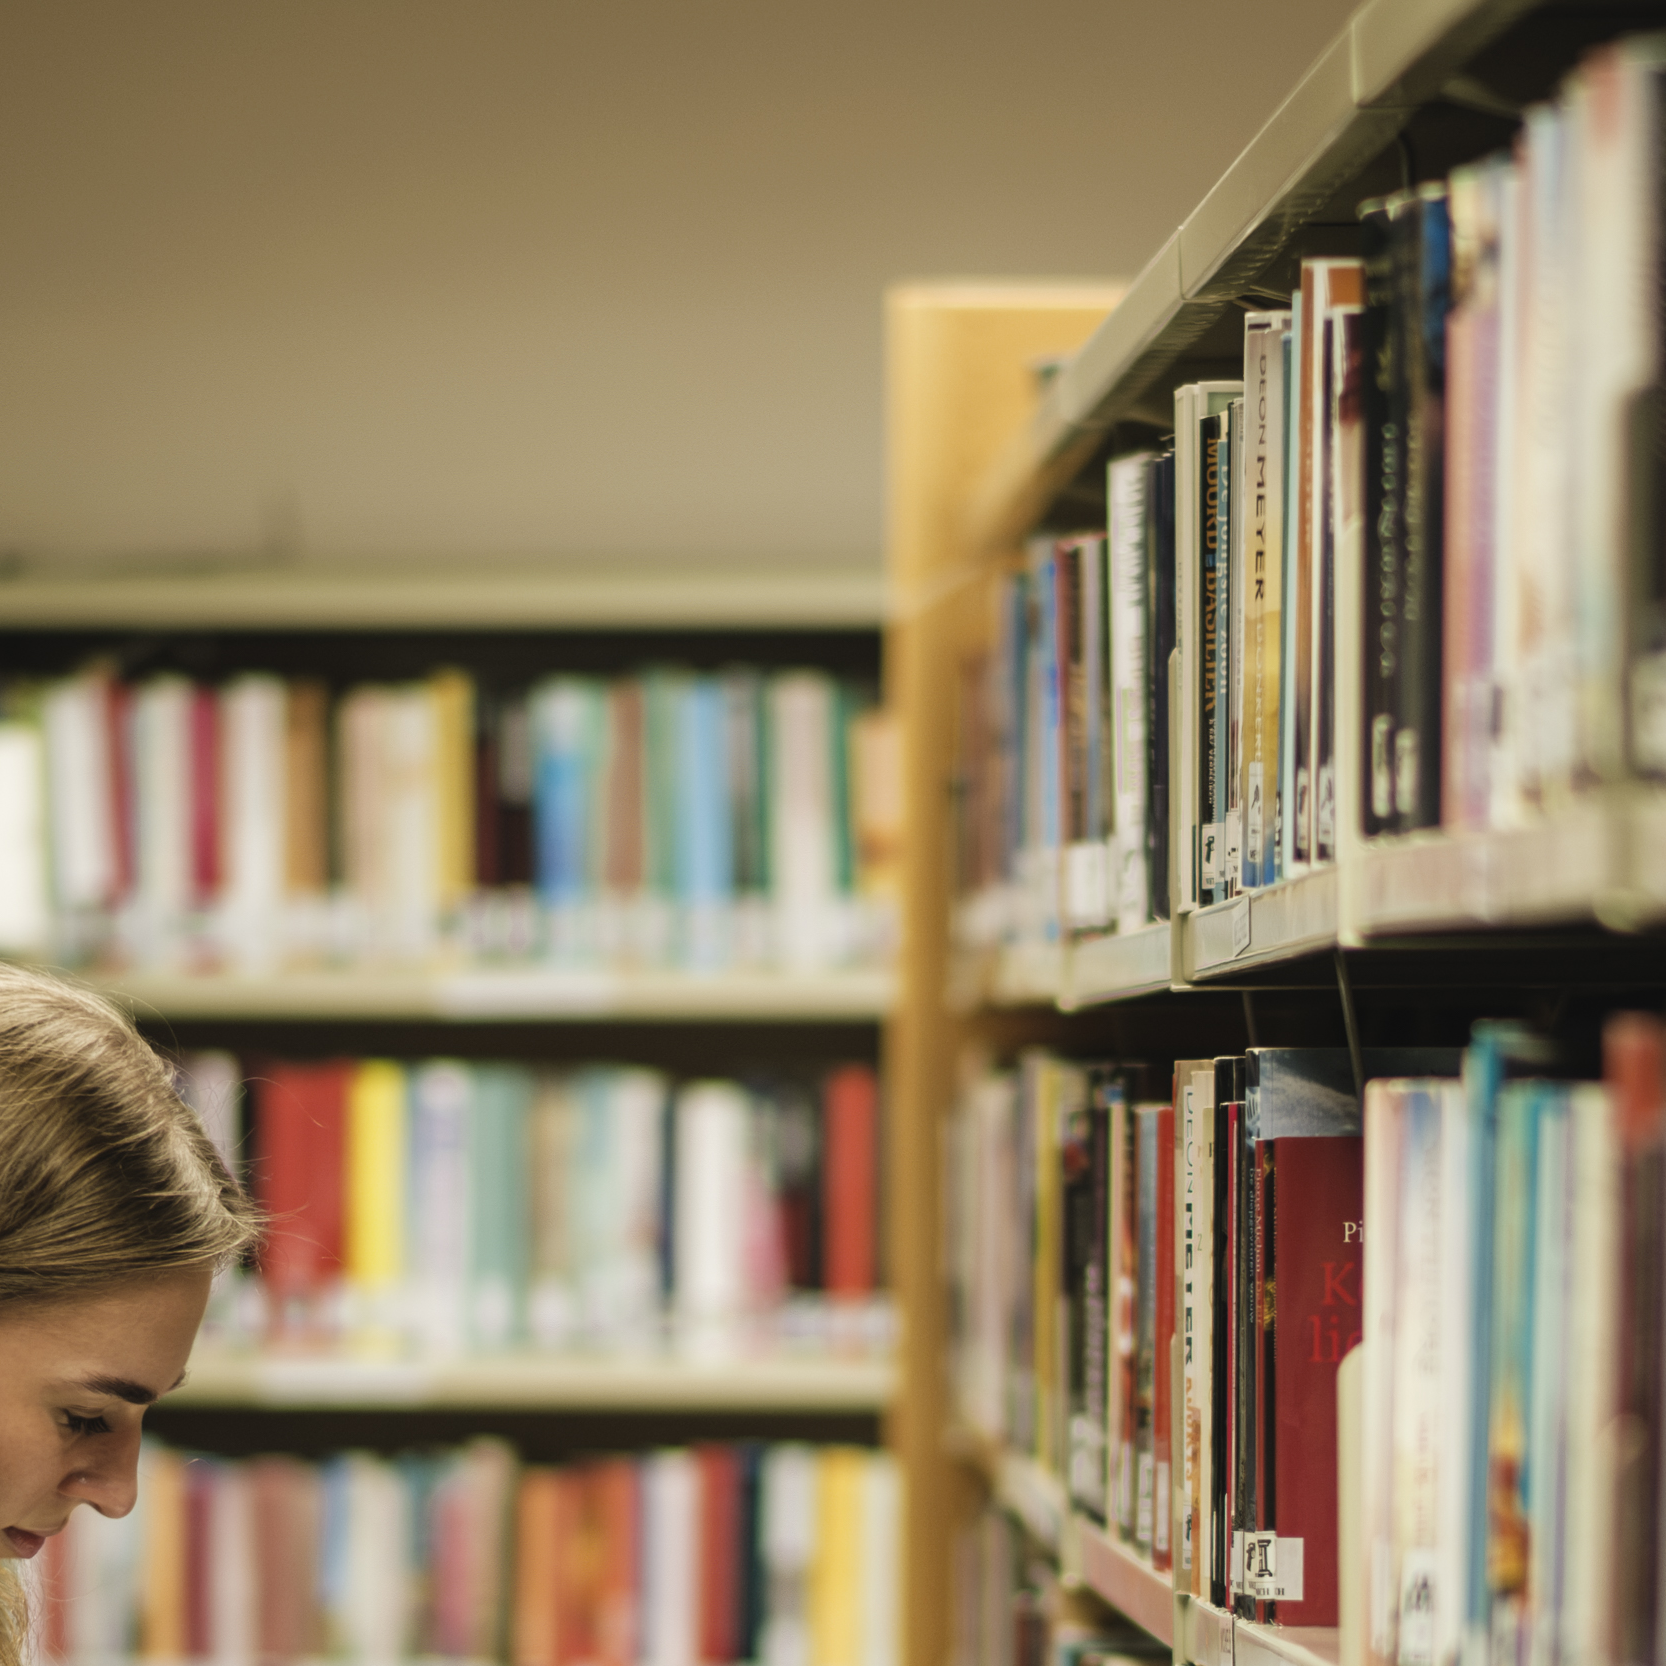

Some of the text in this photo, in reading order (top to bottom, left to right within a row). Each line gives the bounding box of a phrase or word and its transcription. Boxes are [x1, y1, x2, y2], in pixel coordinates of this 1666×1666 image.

[1256, 353, 1269, 446] DEON
[1254, 456, 1268, 601] MEYER
[1321, 1261, 1363, 1307] K
